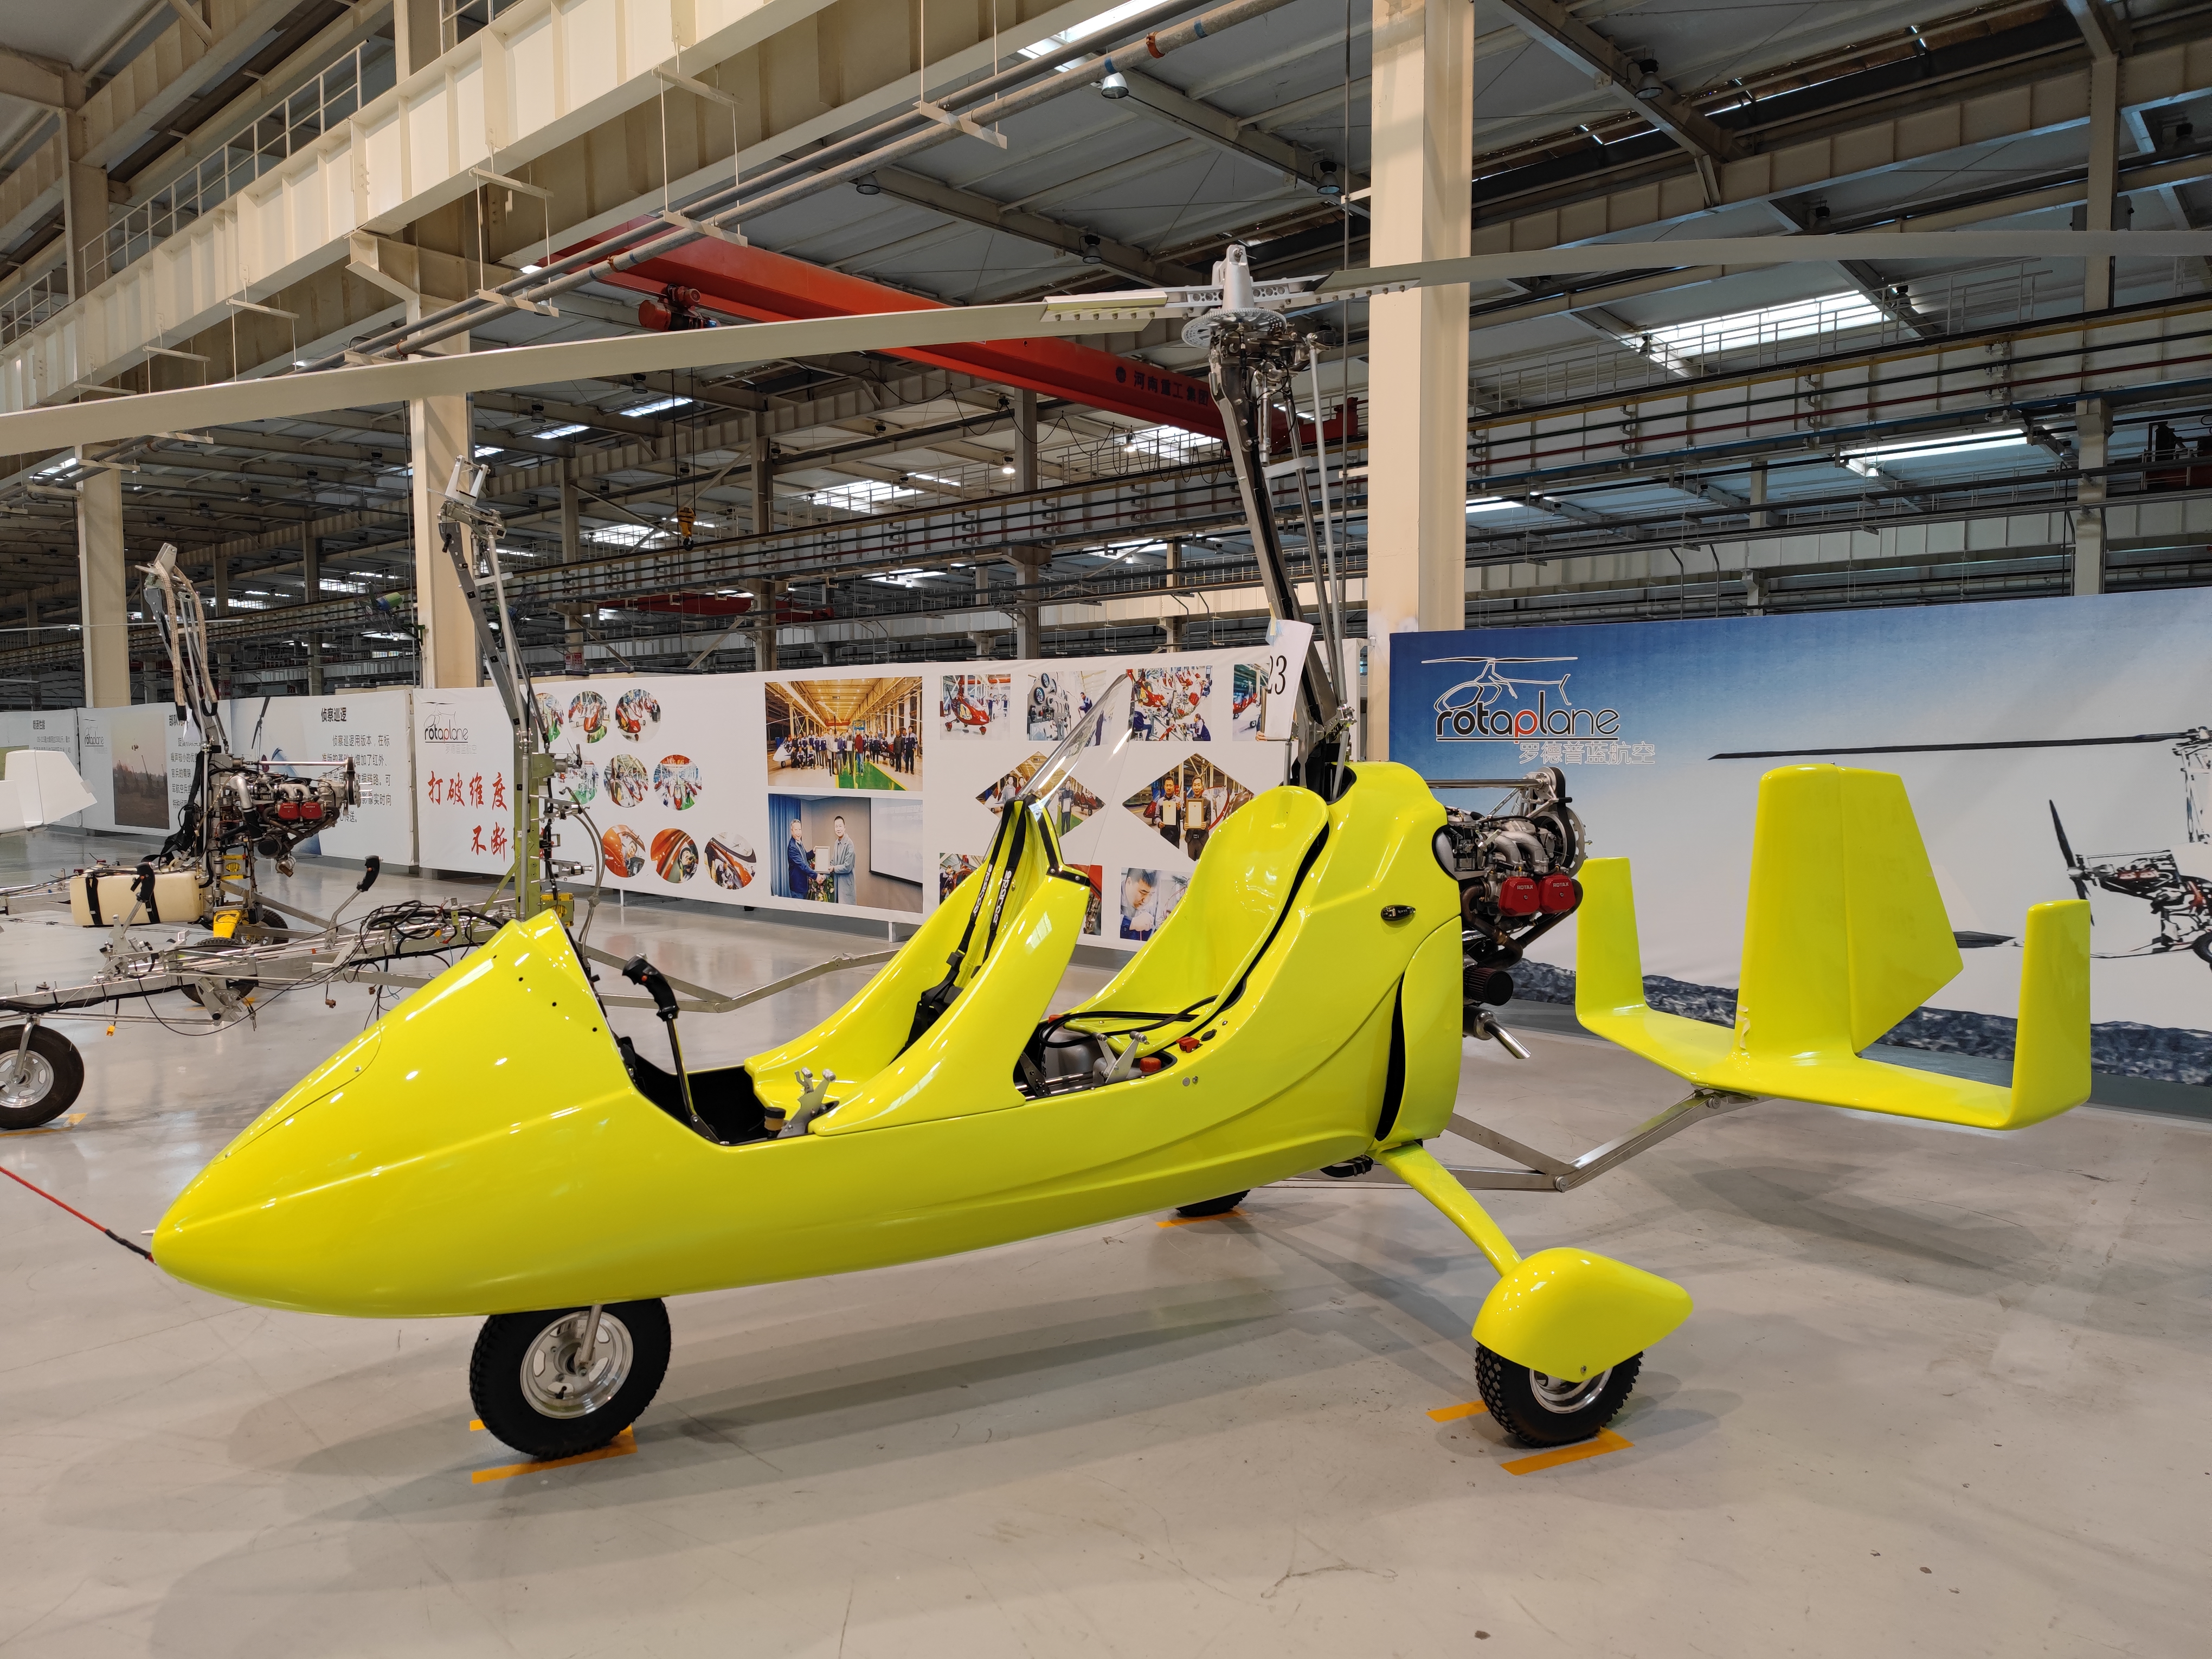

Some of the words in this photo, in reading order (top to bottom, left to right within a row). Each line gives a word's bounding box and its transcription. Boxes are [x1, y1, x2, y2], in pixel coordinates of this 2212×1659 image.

[1134, 370, 1208, 406] 河南重工集团
[321, 707, 347, 722] 侦察巡逻
[1436, 691, 1621, 744] rotaplane
[425, 719, 469, 741] rotaplane
[1519, 741, 1655, 765] 罗德普蓝航空
[993, 870, 1012, 925] sparco
